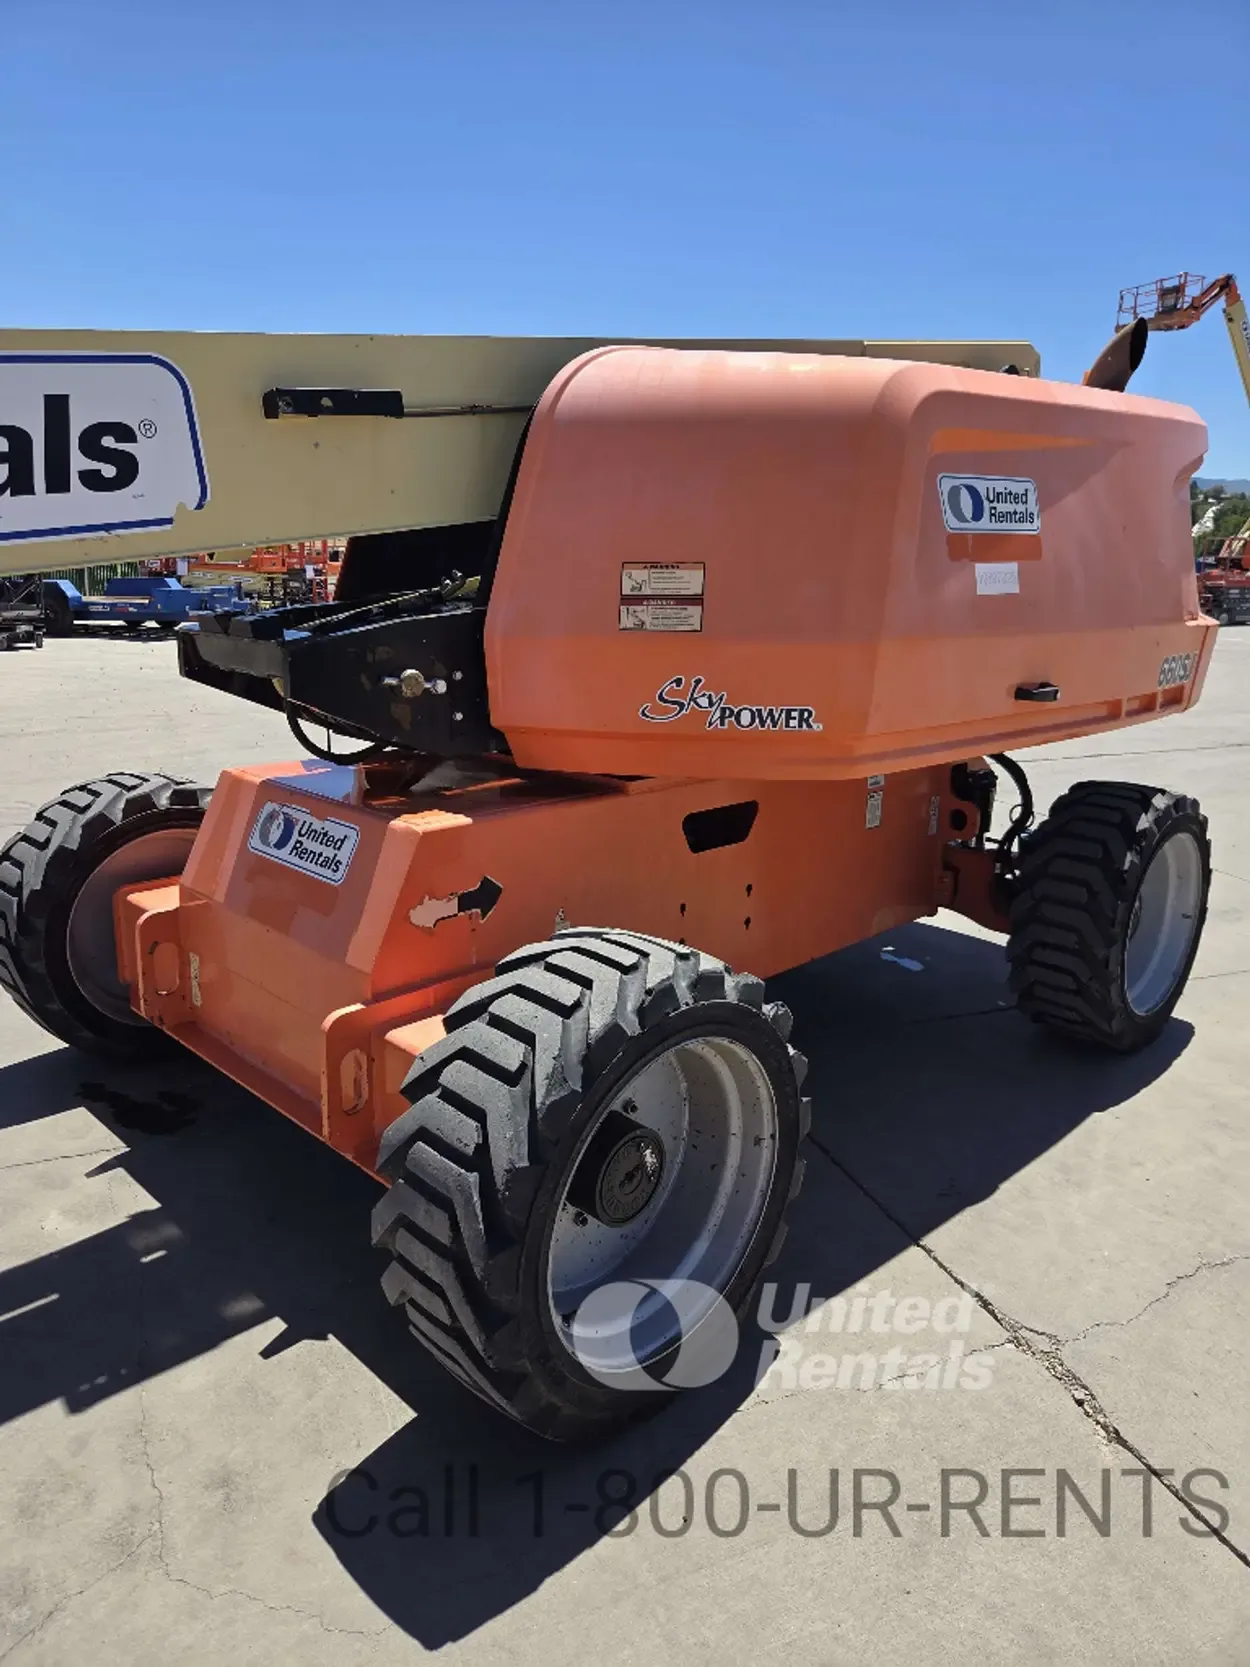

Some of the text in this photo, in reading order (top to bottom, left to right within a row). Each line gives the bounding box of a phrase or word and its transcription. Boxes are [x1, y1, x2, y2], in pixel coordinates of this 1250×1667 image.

[985, 486, 1029, 505] United
[989, 506, 1035, 525] Rentals
[298, 820, 348, 852] United
[288, 839, 343, 873] Rentals
